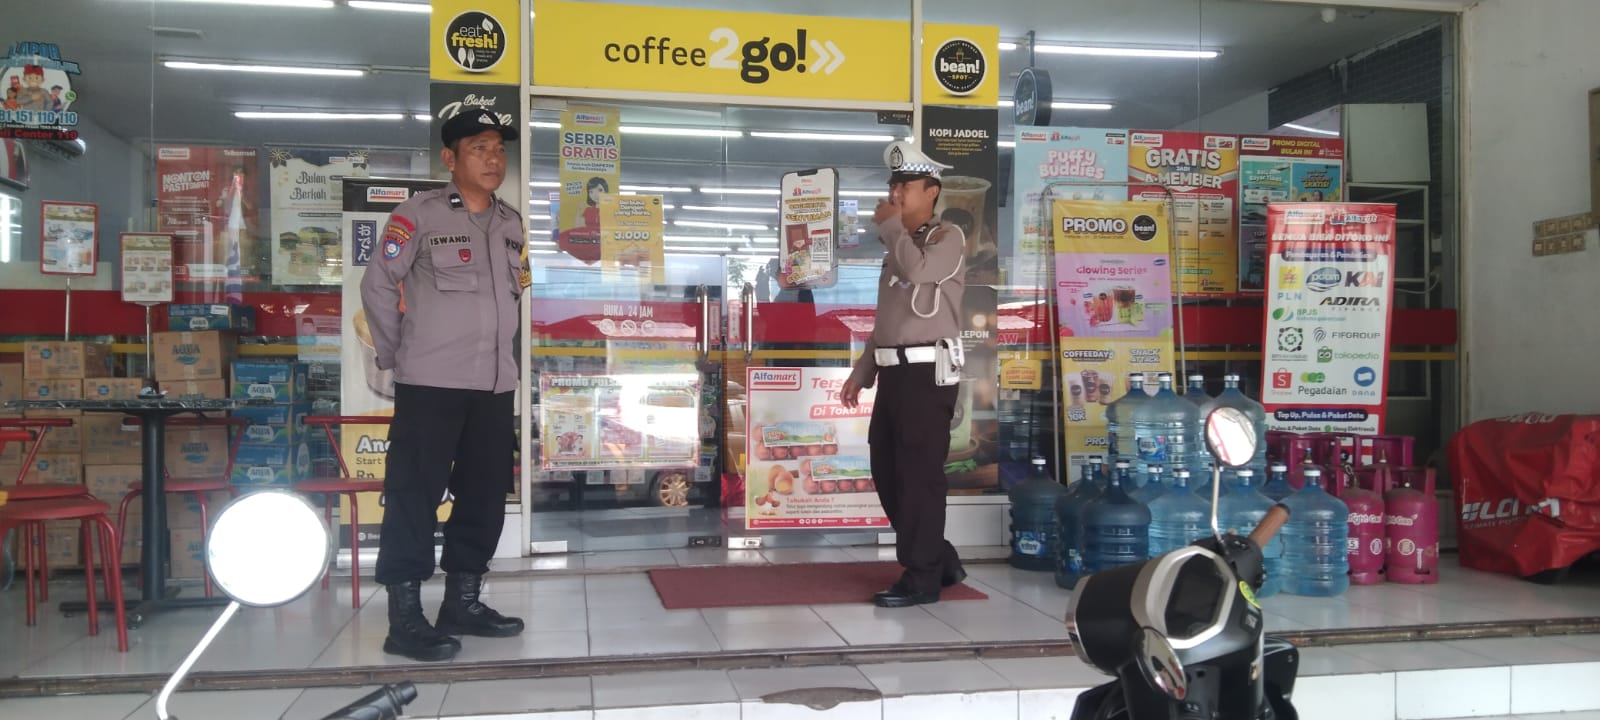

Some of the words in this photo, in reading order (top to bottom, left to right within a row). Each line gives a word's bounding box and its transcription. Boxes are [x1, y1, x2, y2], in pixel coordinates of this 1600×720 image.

[459, 24, 482, 37] eat
[451, 32, 498, 49] fresh!
[940, 58, 980, 74] bean!
[463, 93, 497, 106] Baked
[16, 110, 34, 123] 151
[37, 112, 56, 124] 110
[59, 112, 77, 125] 110
[564, 132, 616, 146] SERBA
[929, 128, 952, 138] KOPI
[954, 129, 989, 138] JADOEL
[1271, 139, 1296, 147] PROMO
[1296, 140, 1320, 148] DIGITAL
[562, 146, 618, 160] GRATIS
[1047, 149, 1096, 167] Puffy
[1145, 148, 1221, 171] GRATIS
[1038, 160, 1105, 180] Buddies
[163, 170, 210, 184] NONTON
[295, 171, 326, 185] Bulan
[369, 188, 406, 197] Alfamart
[1062, 217, 1127, 234] PROMO
[430, 235, 471, 246] ISWANDI
[614, 230, 650, 241] 3.000
[357, 223, 372, 262] おでん
[1344, 270, 1385, 288] KAI
[1277, 292, 1302, 300] PLN
[1319, 296, 1381, 306] ADIRA
[603, 303, 623, 316] BUKA
[628, 304, 638, 316] 24
[639, 305, 654, 318] JAM
[1296, 308, 1318, 316] BPJS
[1331, 331, 1381, 340] FIFGROUP
[172, 343, 200, 354] AQUA
[1063, 349, 1115, 360] COFFEEDAYS
[1334, 351, 1380, 360] tokopedia
[753, 371, 797, 381] Alfamart
[1297, 385, 1348, 397] Pegadaian
[813, 406, 827, 417] Di
[830, 406, 858, 416] Toko
[356, 456, 382, 465] Start
